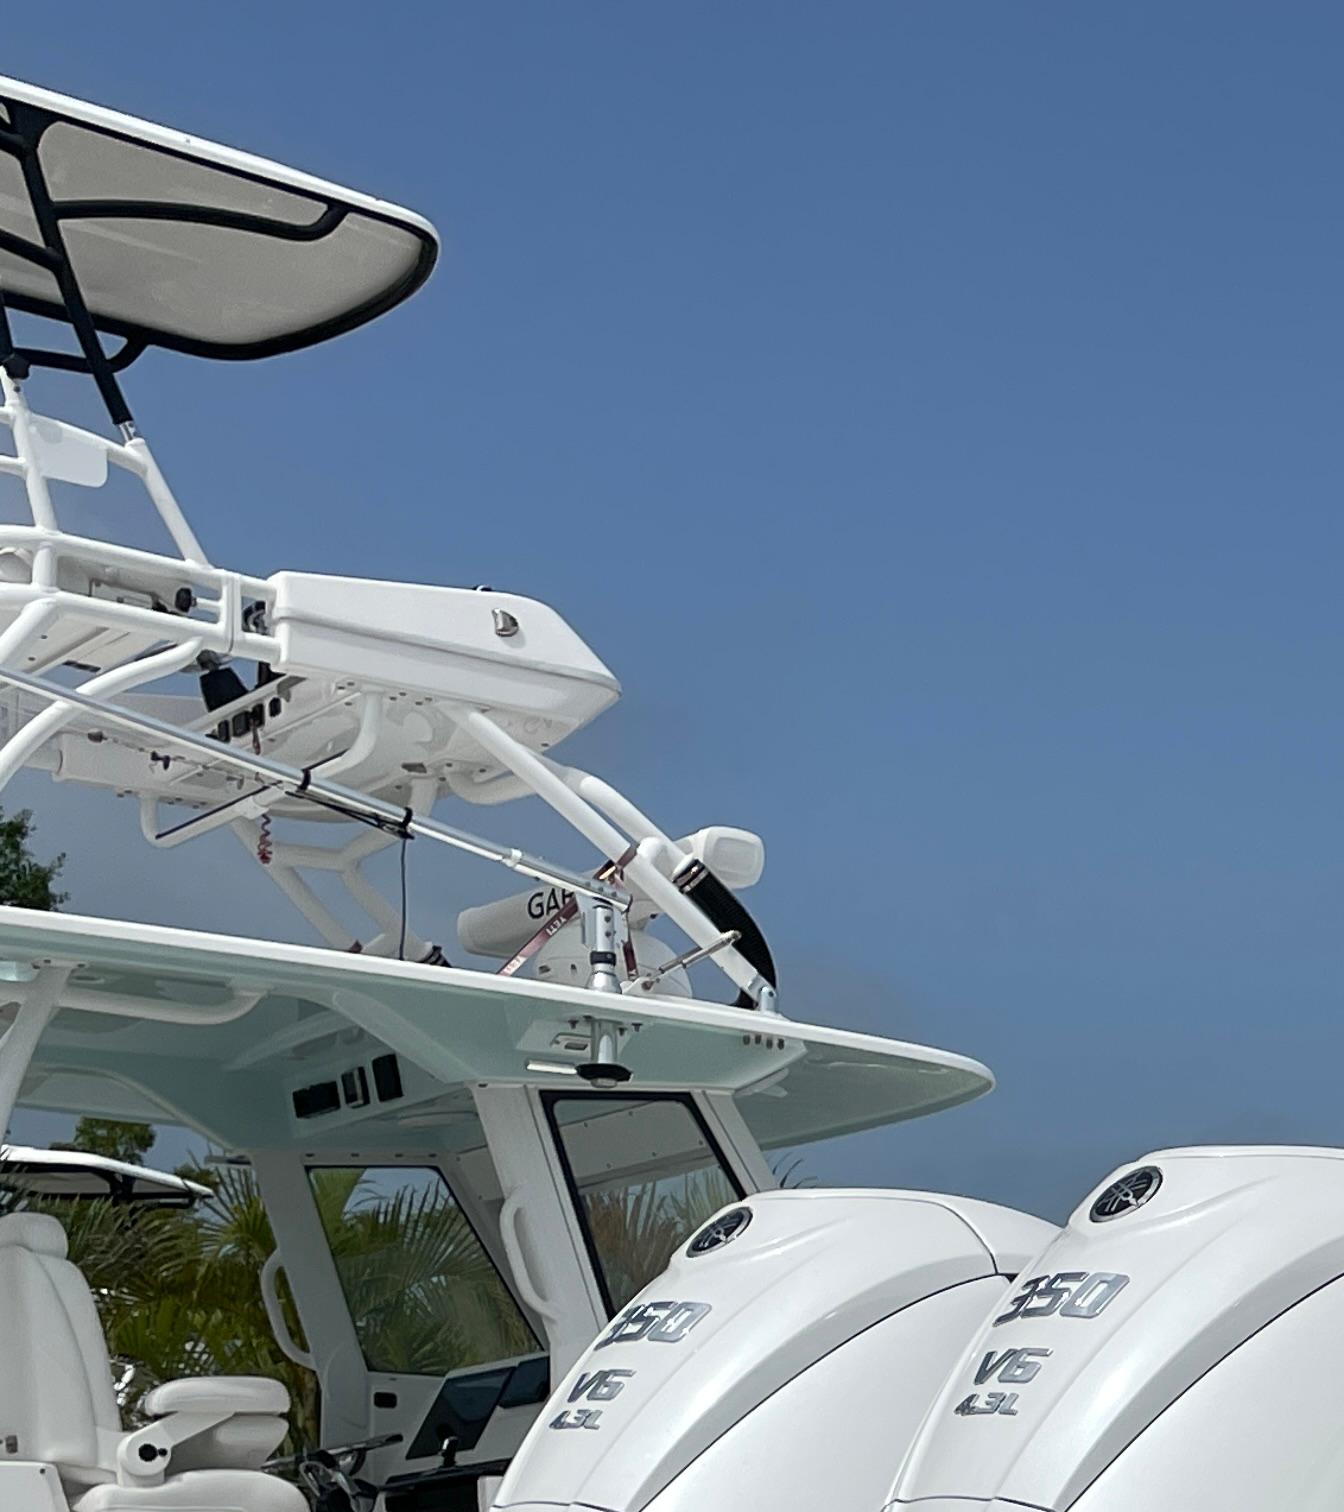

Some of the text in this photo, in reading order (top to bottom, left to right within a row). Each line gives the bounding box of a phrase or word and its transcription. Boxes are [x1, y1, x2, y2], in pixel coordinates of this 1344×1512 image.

[992, 1271, 1131, 1328] 350
[594, 1300, 713, 1351] 350
[567, 1369, 638, 1403] V6
[973, 1347, 1054, 1386] V6
